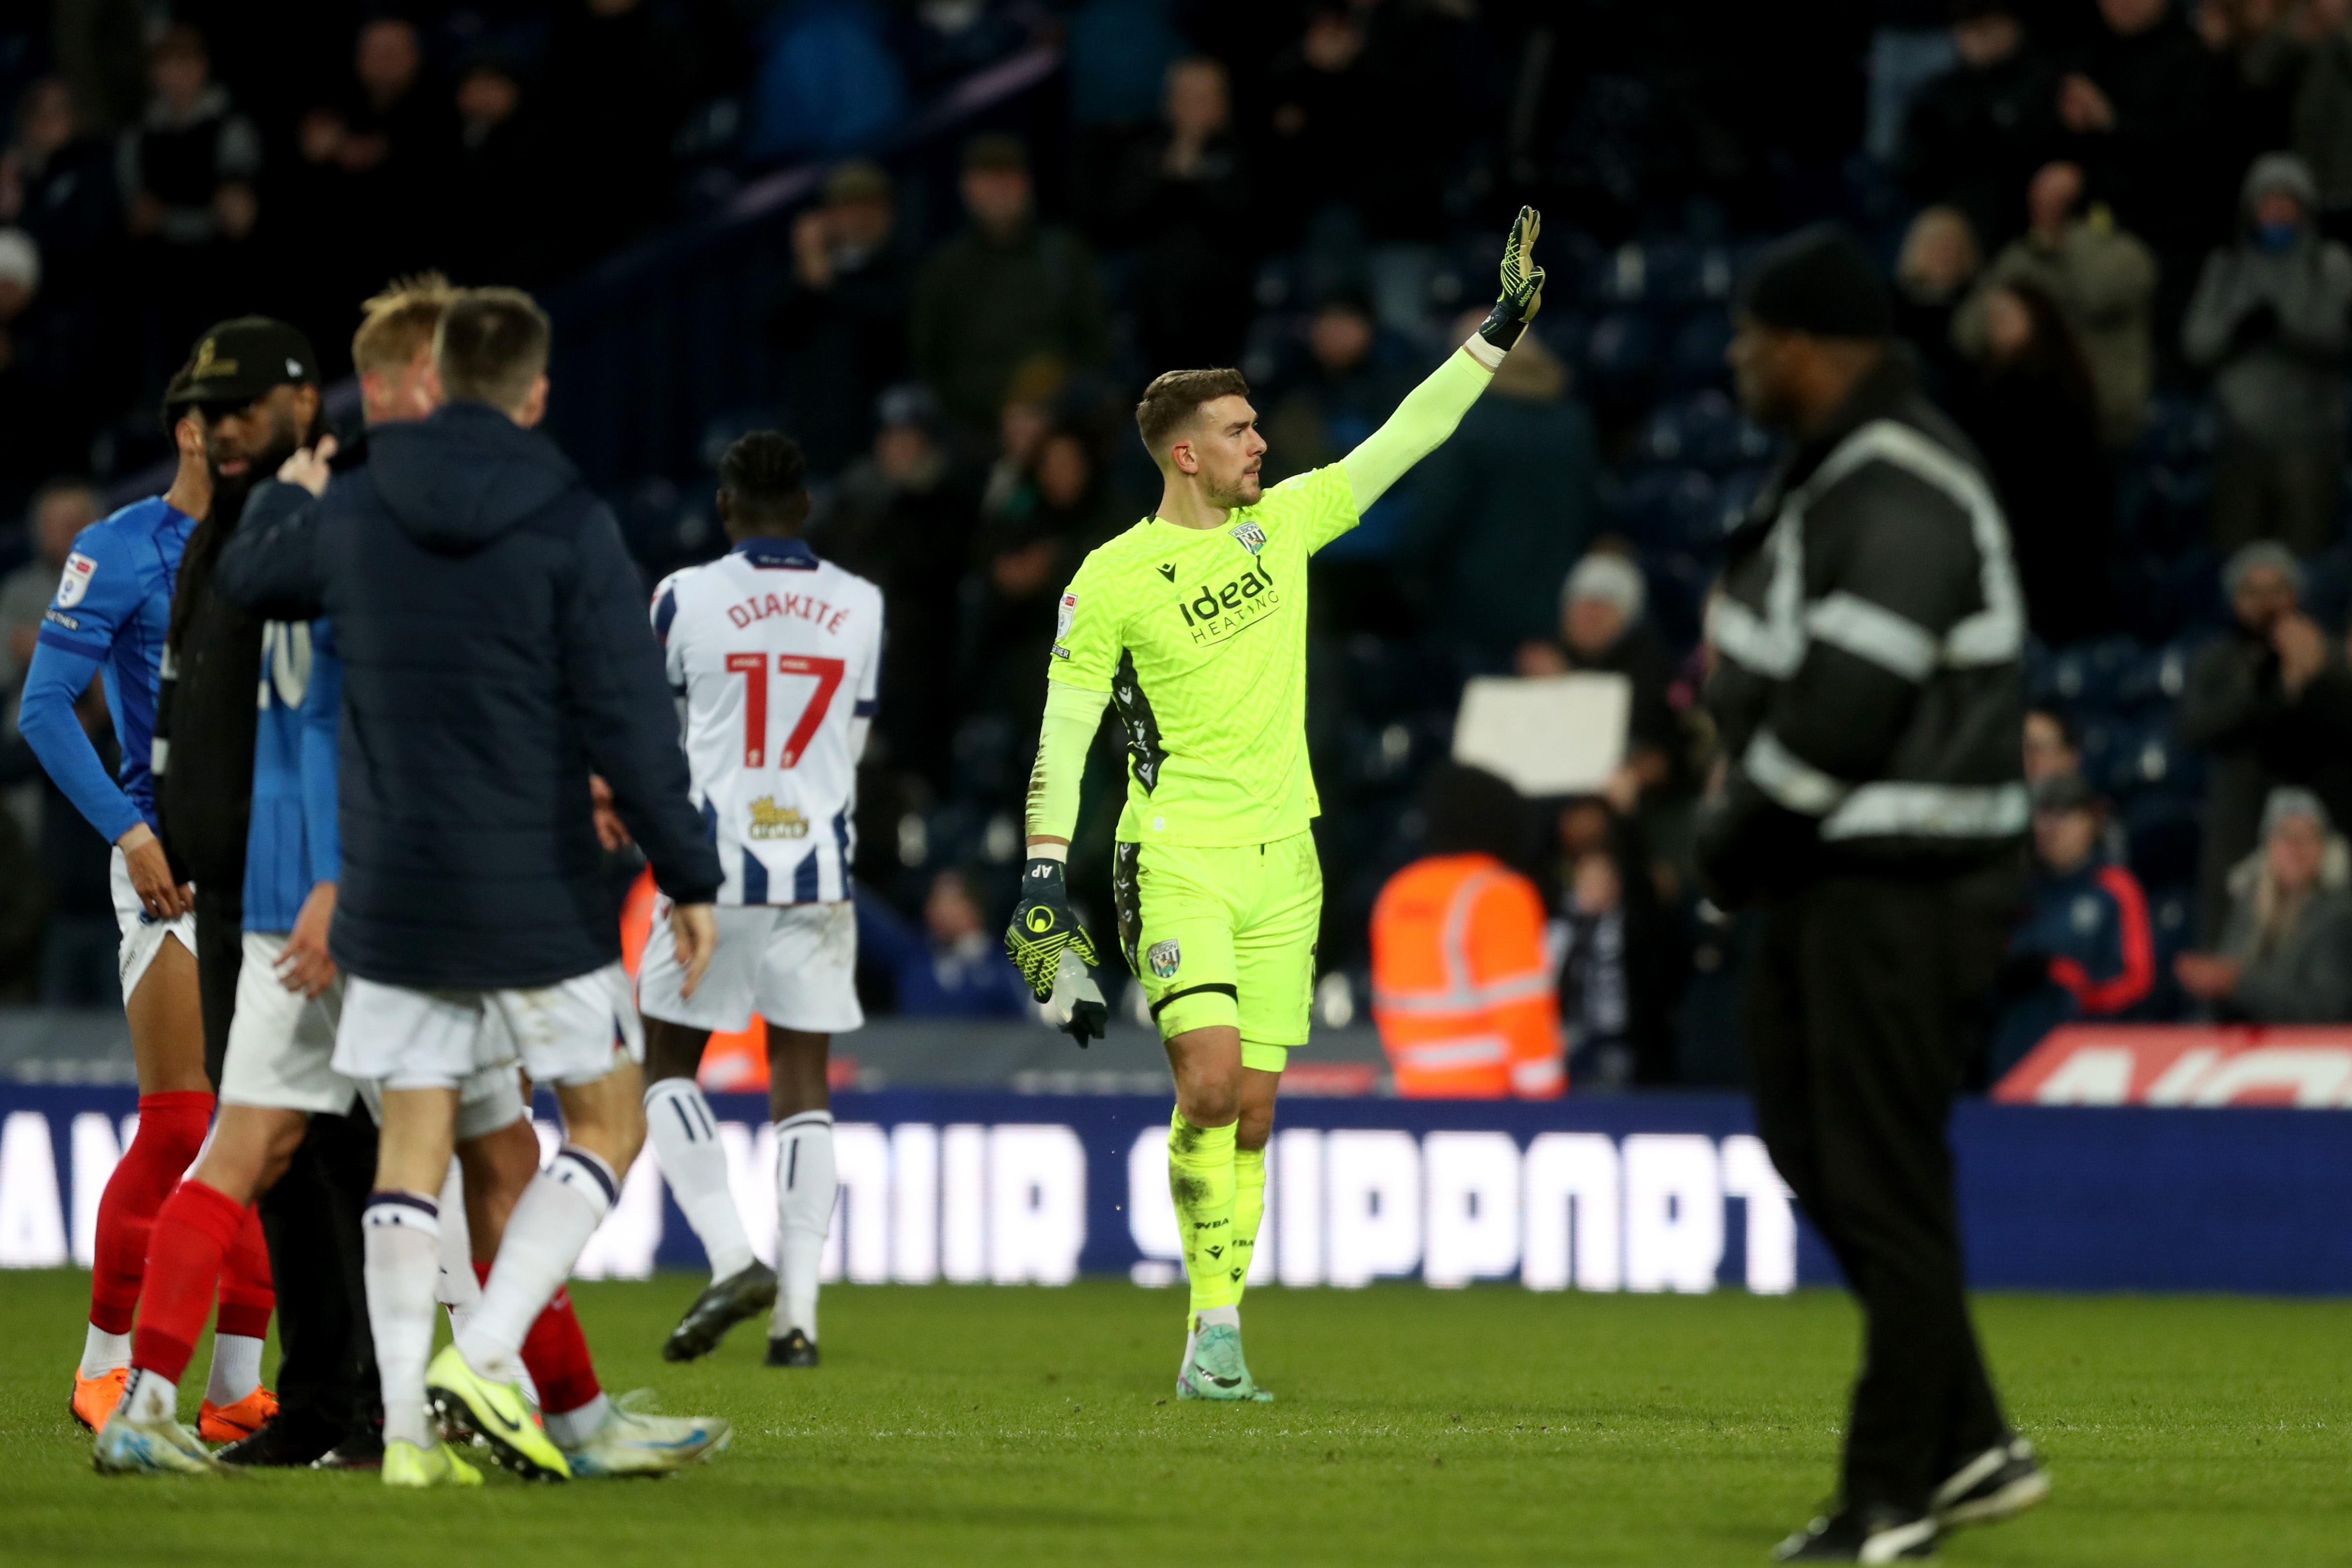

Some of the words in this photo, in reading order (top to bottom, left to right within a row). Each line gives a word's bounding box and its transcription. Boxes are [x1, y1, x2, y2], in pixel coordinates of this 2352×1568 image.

[1519, 285, 1536, 307] uhlsport
[1234, 524, 1258, 537] ALBION
[728, 592, 850, 635] DIAKITÉ
[1191, 590, 1279, 644] HEATING
[725, 652, 845, 769] 17
[1031, 864, 1053, 878] AP
[1149, 942, 1176, 957] ALBION
